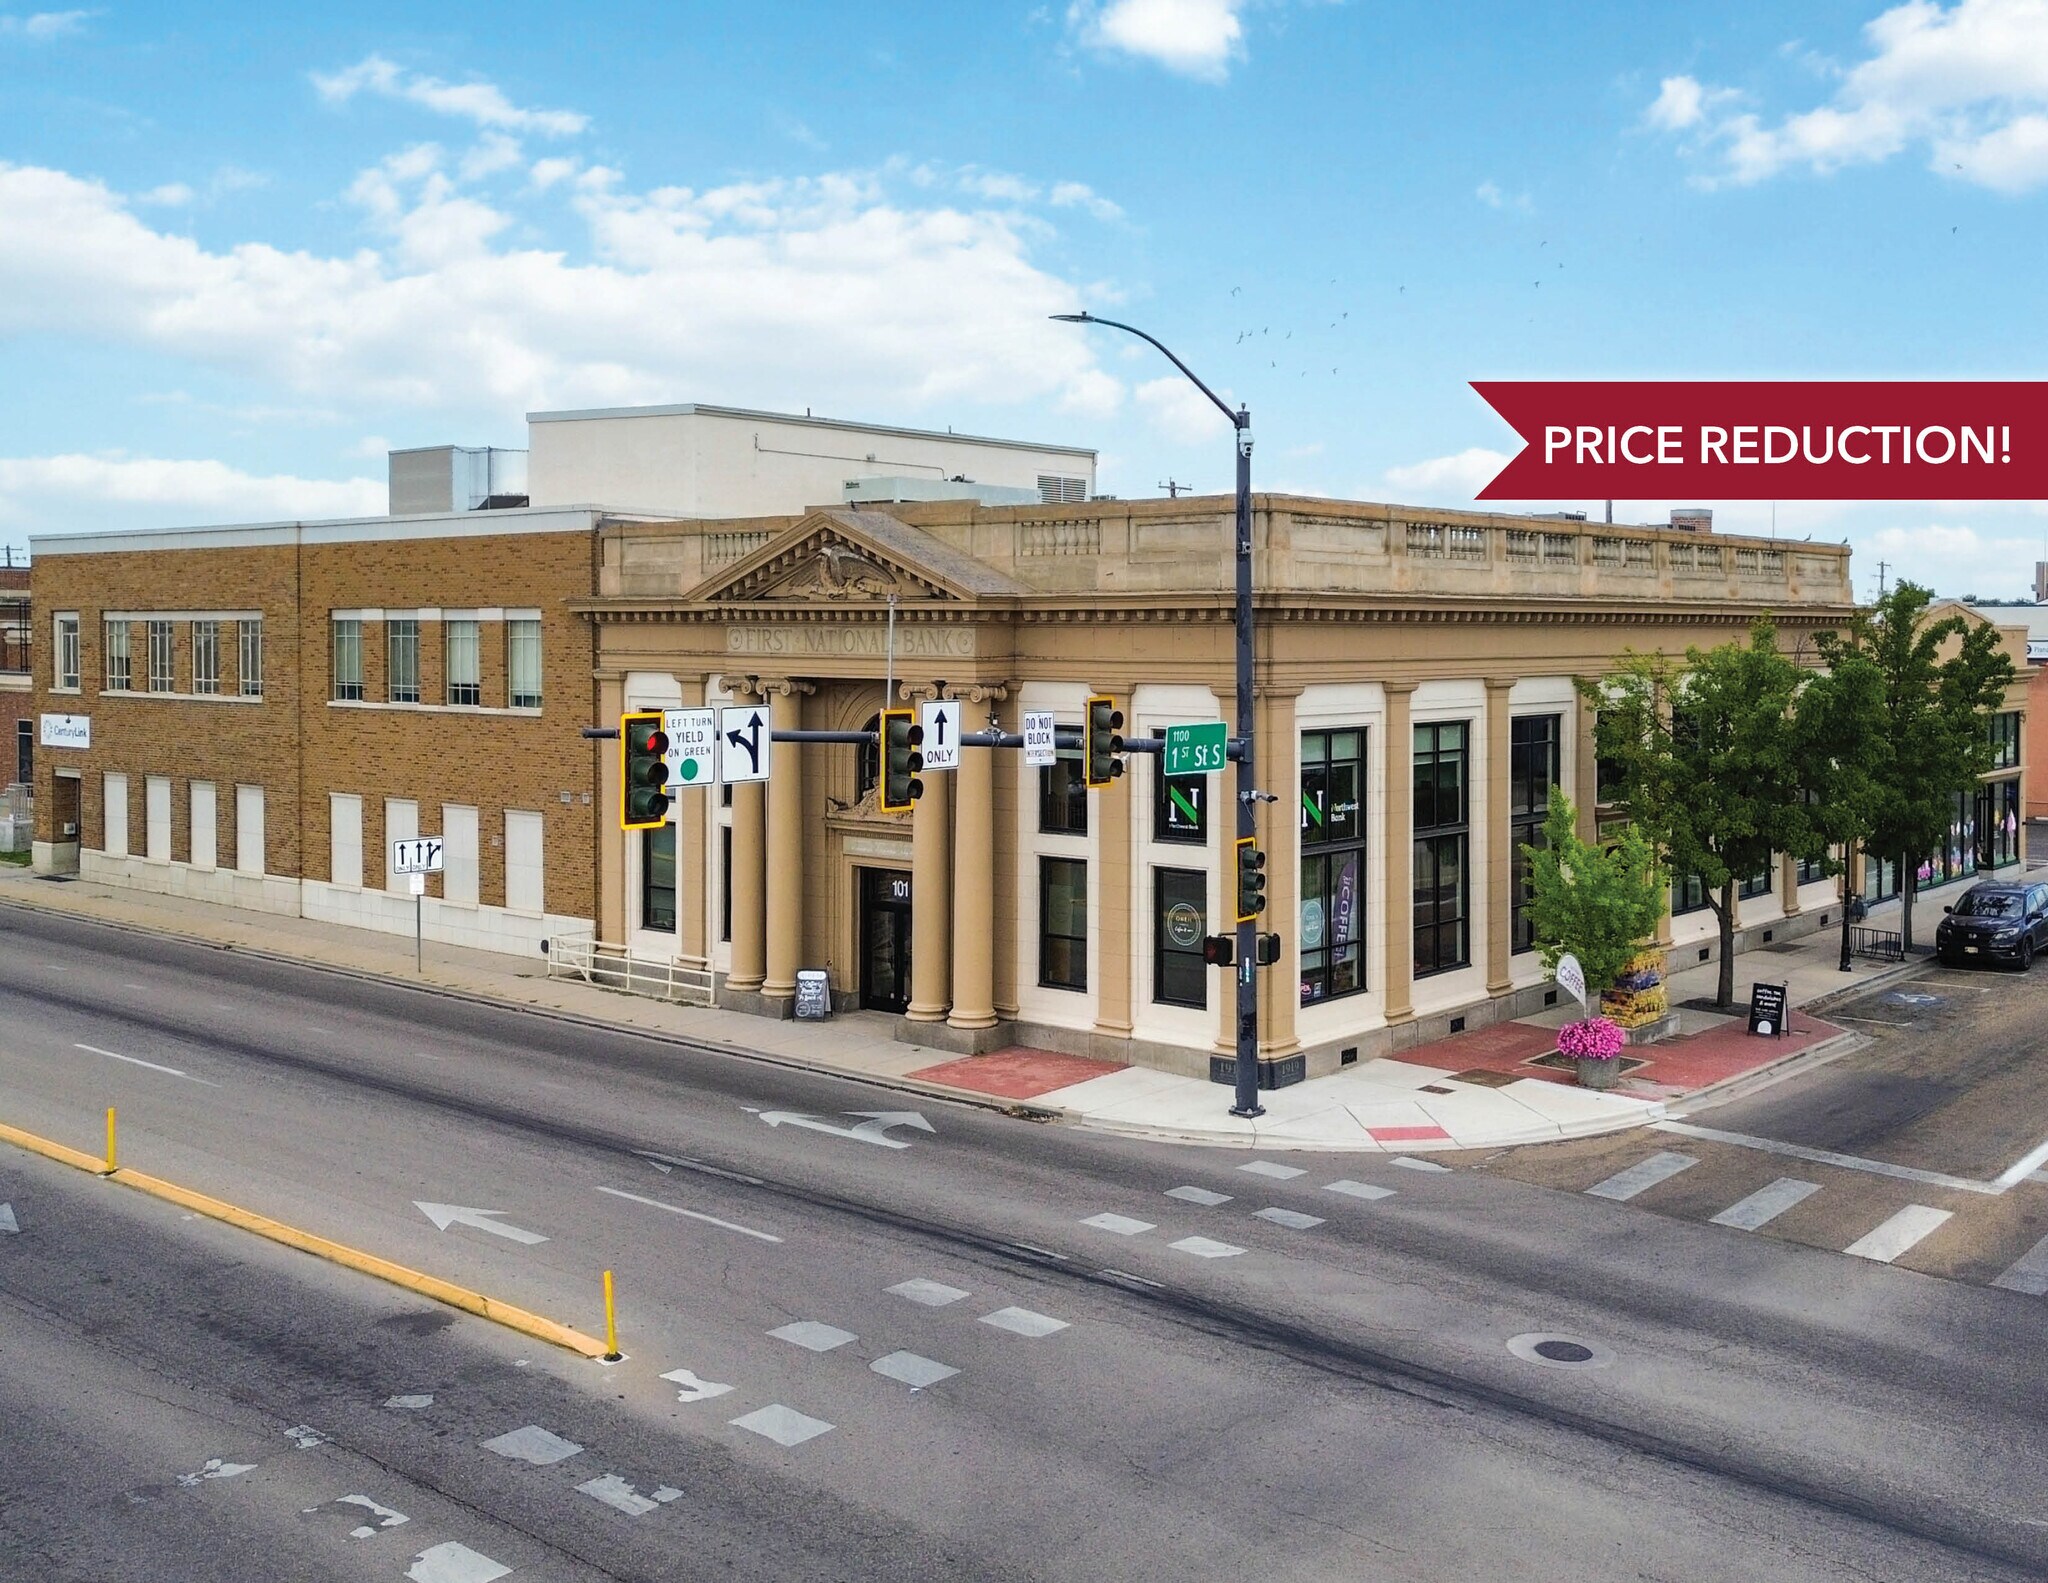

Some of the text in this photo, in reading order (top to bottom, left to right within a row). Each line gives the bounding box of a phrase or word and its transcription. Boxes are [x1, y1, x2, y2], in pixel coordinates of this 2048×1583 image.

[746, 628, 953, 654] FIRST NATIONAL BANK
[666, 717, 712, 728] LEFT TURN
[1026, 717, 1052, 730] DO NOT
[54, 725, 87, 738] CenturyLink
[676, 730, 704, 743] YIELD
[1173, 730, 1190, 742] 1100
[1028, 732, 1051, 745] BLOCK
[668, 746, 711, 757] ON GREEN
[927, 749, 953, 763] ONLY
[1194, 744, 1208, 767] St
[1212, 743, 1221, 766] S
[892, 880, 909, 898] 101
[1560, 966, 1584, 994] COFFEE
[1282, 1061, 1300, 1075] 1919
